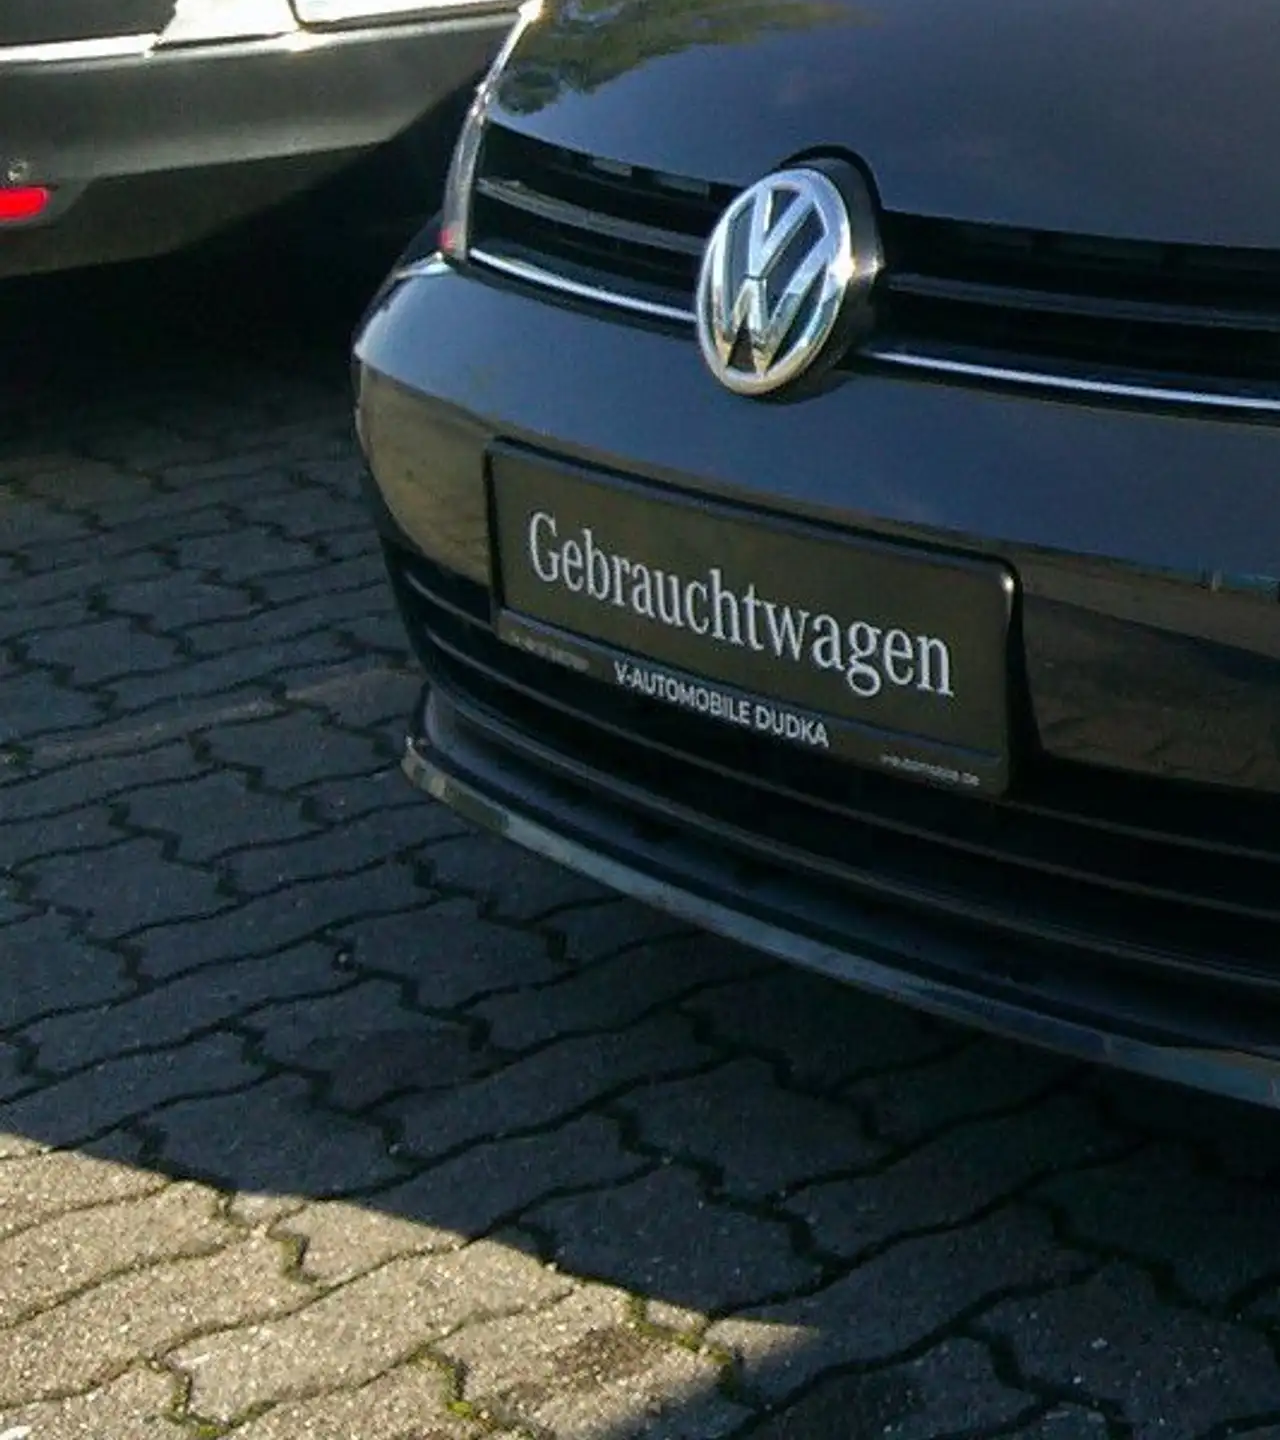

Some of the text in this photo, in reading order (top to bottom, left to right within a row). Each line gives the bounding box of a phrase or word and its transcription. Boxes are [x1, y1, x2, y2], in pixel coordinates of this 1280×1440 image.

[529, 511, 954, 698] Gebrauchtwagen
[614, 659, 830, 749] V-AUTOMOBILE DUDKA
